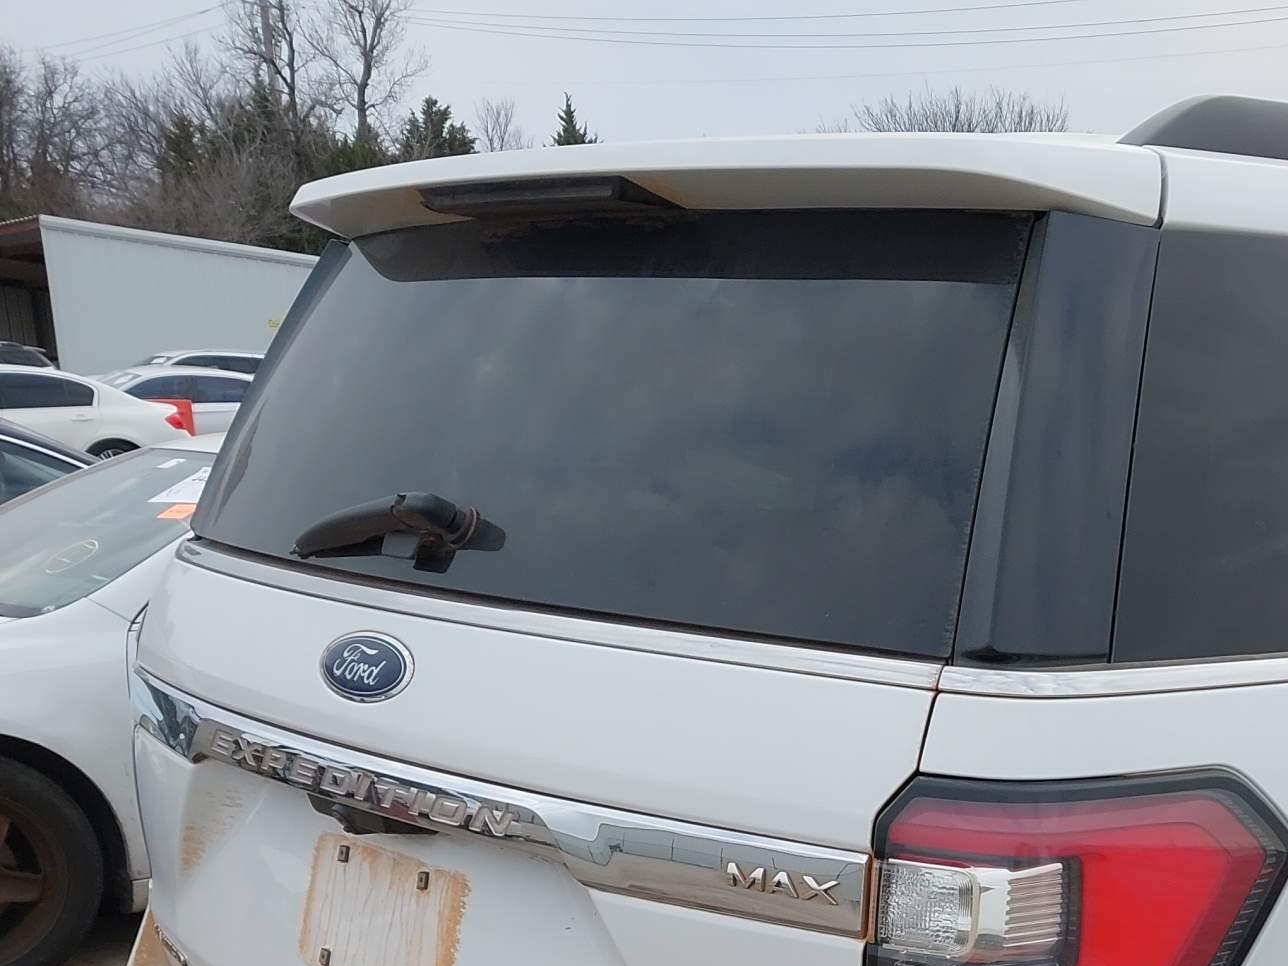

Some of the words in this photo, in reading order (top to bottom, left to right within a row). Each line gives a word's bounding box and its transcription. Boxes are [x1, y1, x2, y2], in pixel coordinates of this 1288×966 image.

[333, 643, 387, 685] Ford
[210, 728, 514, 837] EXPEDITION
[726, 861, 841, 905] MAX
